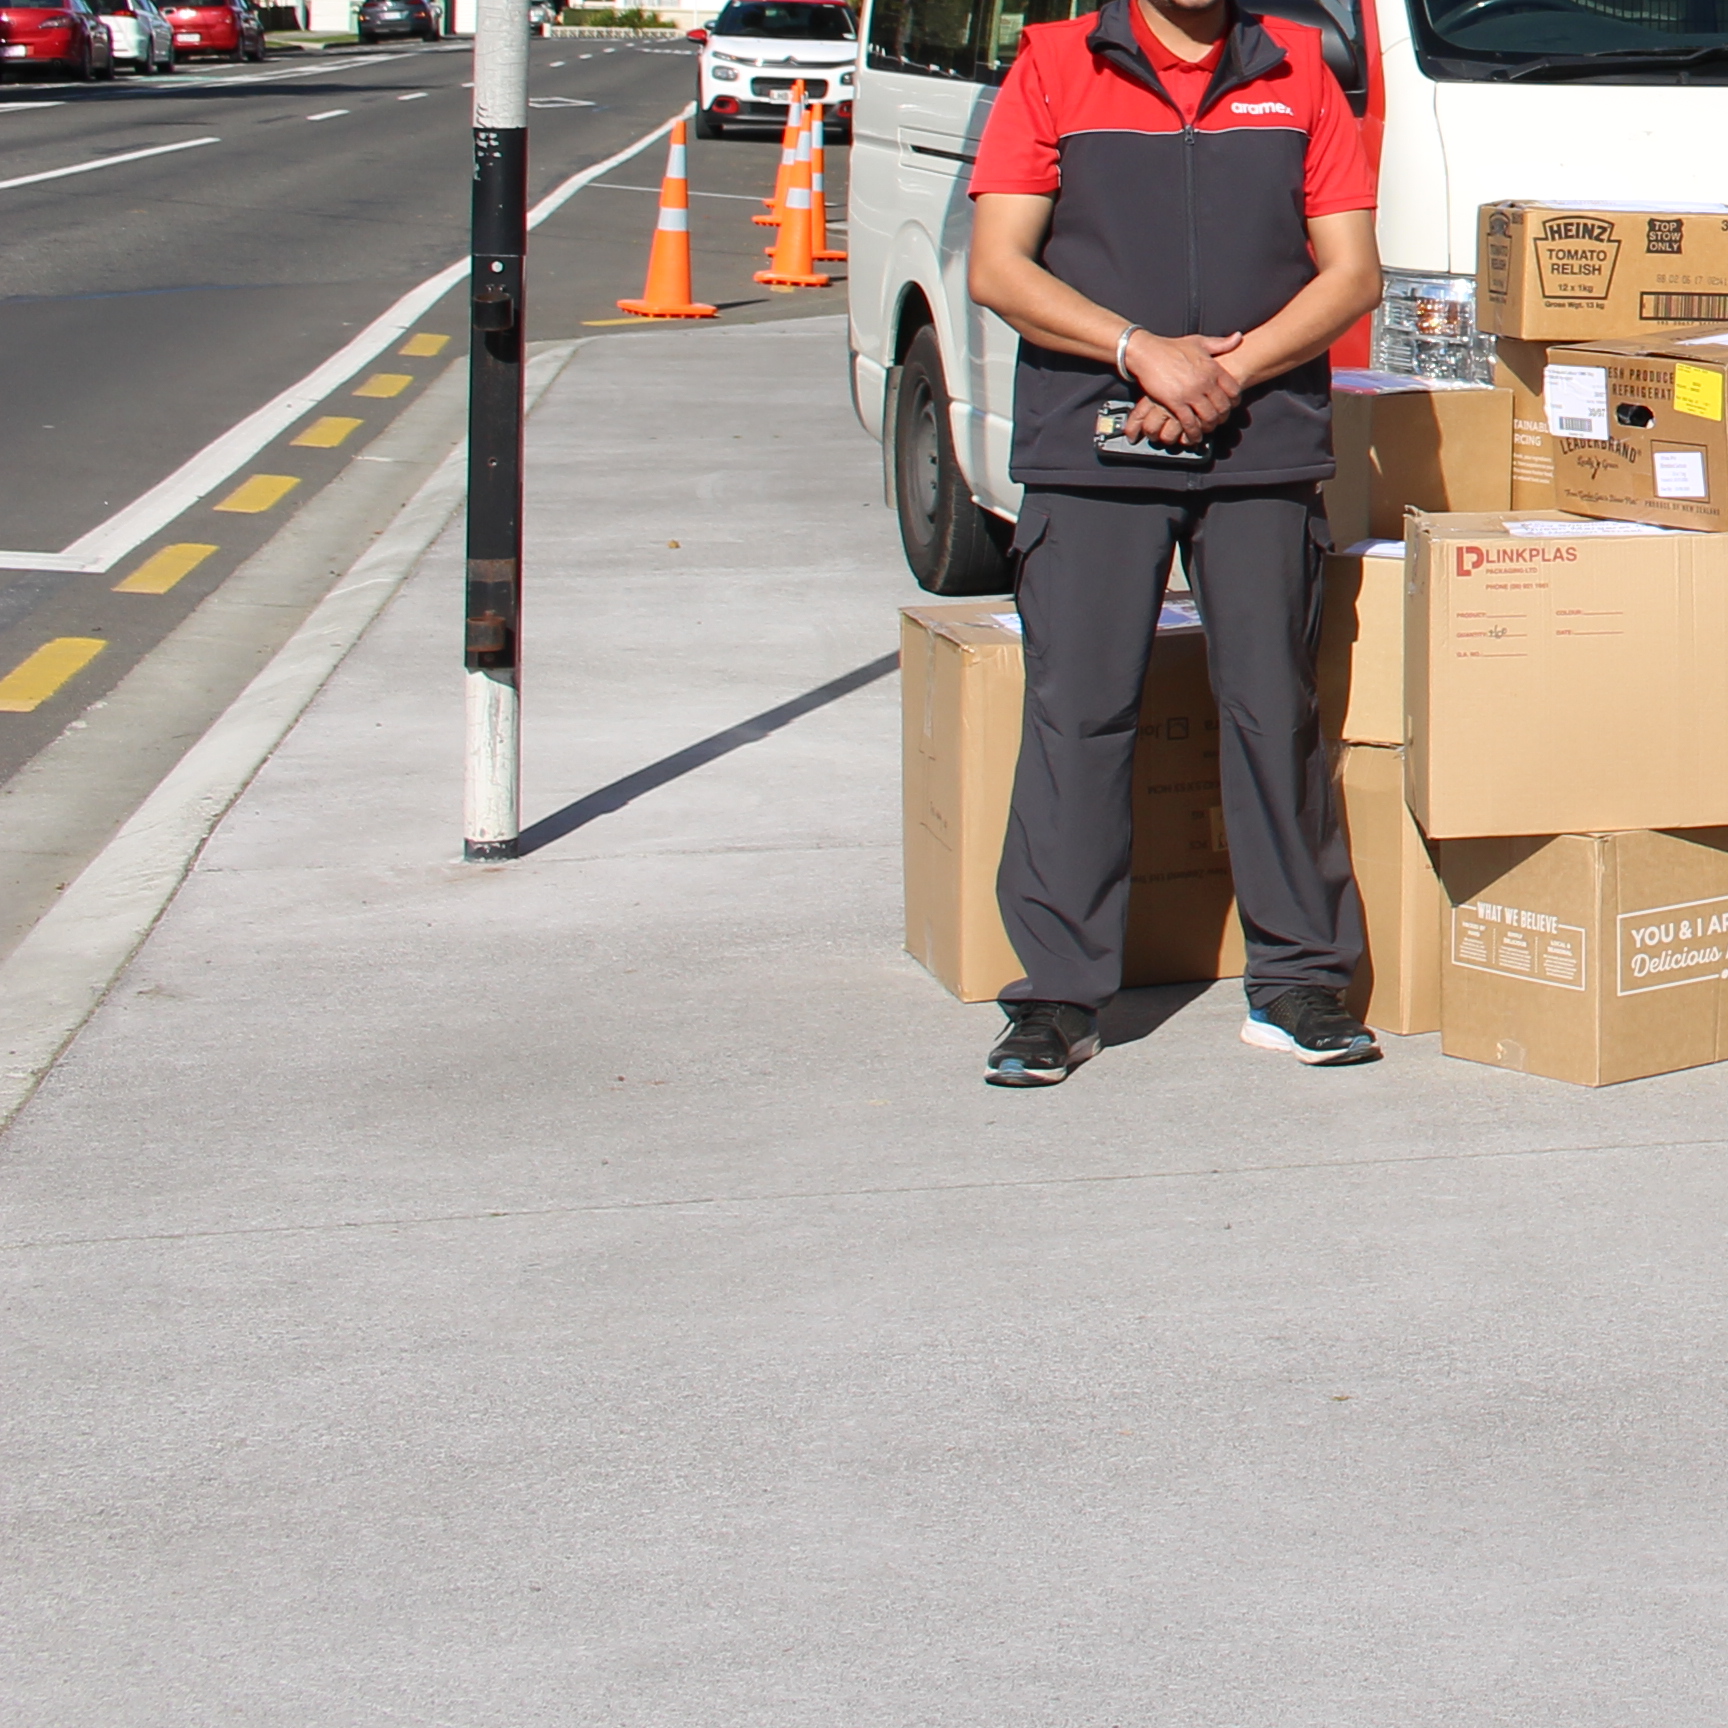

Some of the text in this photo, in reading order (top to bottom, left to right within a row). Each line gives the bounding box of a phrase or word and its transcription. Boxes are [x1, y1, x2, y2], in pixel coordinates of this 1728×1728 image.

[1549, 222, 1608, 243] HEINZ
[1653, 221, 1677, 232] TOP
[1649, 232, 1682, 242] STOW
[1650, 242, 1680, 252] ONLY
[1547, 248, 1607, 262] TOMATO
[1550, 263, 1602, 276] RELISH
[1558, 283, 1568, 292] 12
[1580, 283, 1594, 294] 1kg
[1544, 301, 1565, 309] Gross
[1596, 302, 1605, 310] kg
[1629, 368, 1675, 384] PRODUCE
[1485, 546, 1578, 564] LINKPLAS
[1477, 900, 1559, 935] WHAT WE BELIEVE
[1630, 922, 1675, 949] YOU
[1678, 920, 1692, 940] &
[1697, 917, 1703, 937] I
[1630, 946, 1723, 978] Delicious
